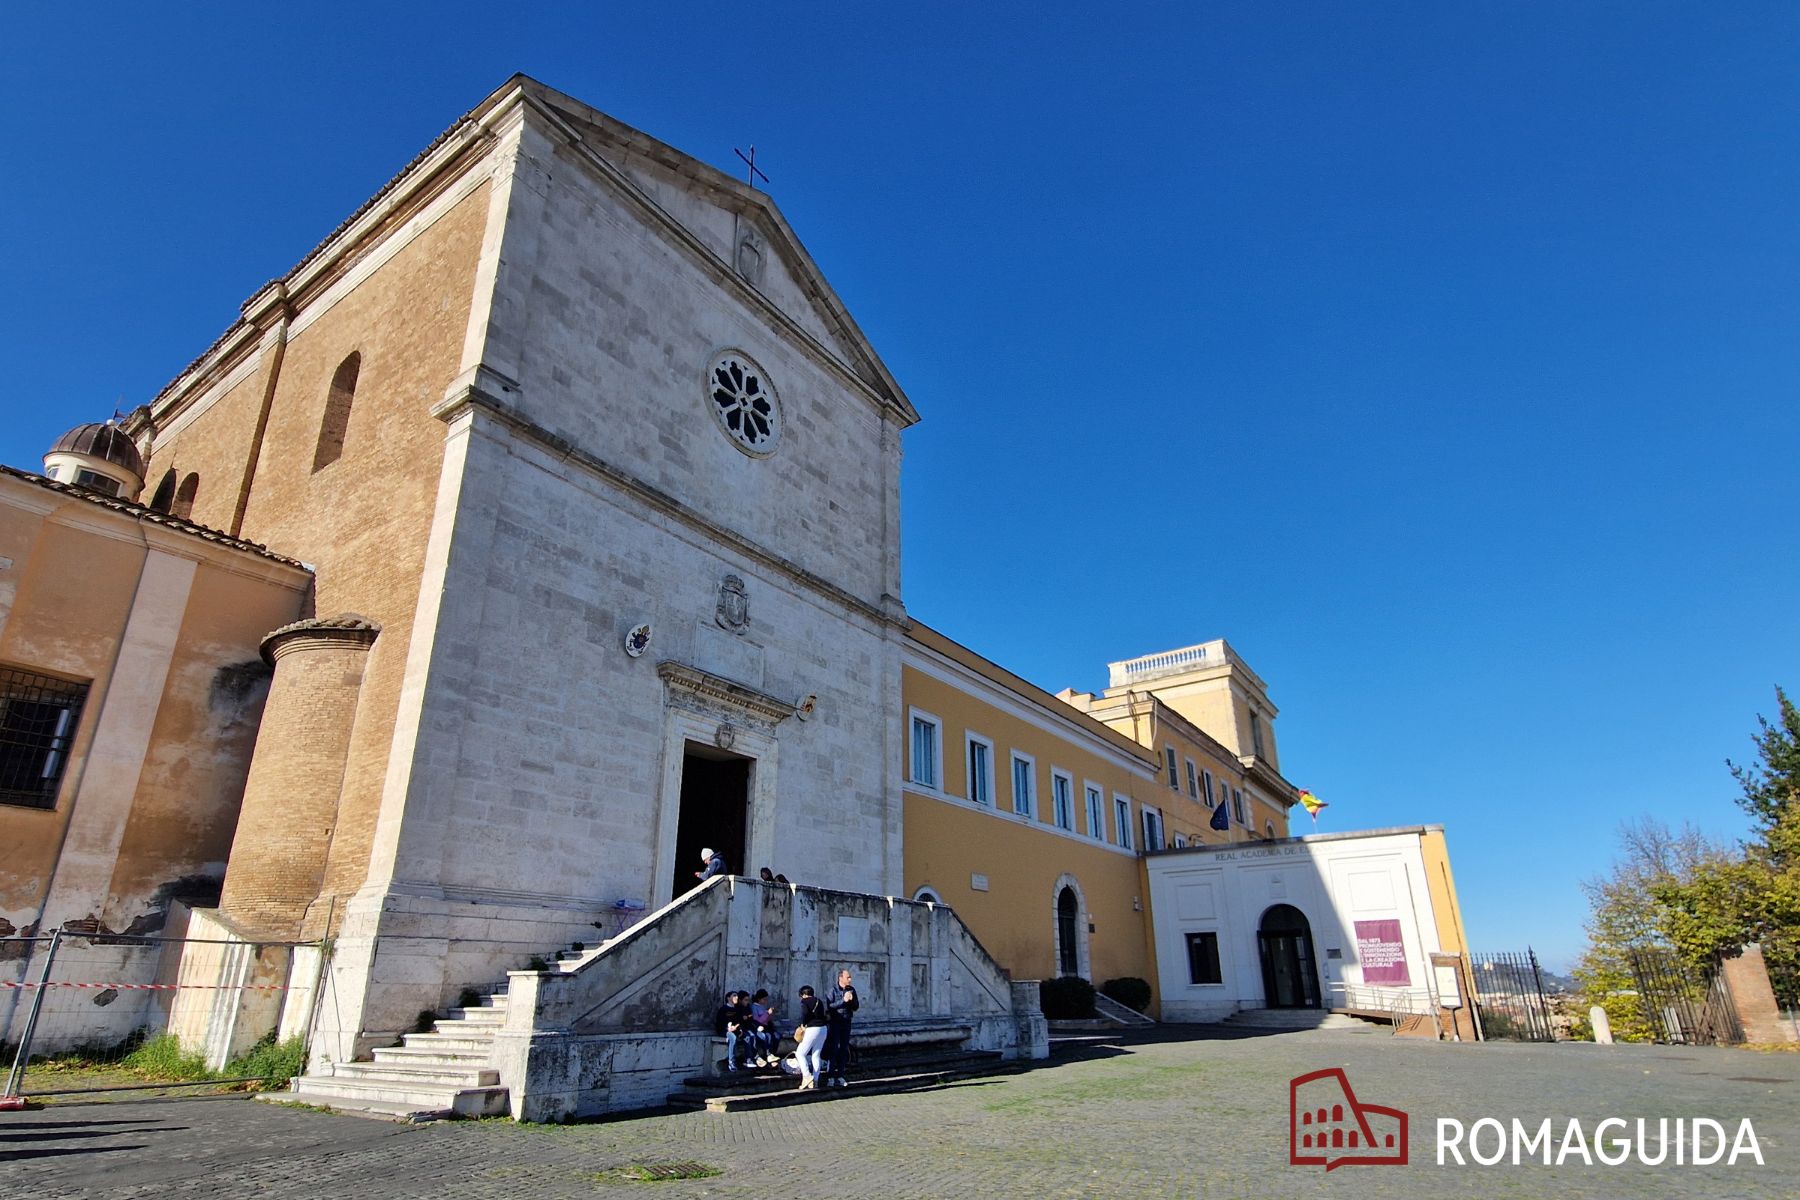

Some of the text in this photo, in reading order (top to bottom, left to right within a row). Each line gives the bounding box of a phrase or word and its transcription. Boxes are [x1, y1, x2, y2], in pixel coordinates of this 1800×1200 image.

[1215, 853, 1238, 862] REAL
[1241, 848, 1282, 859] ACADEMIA
[1284, 847, 1296, 855] DE
